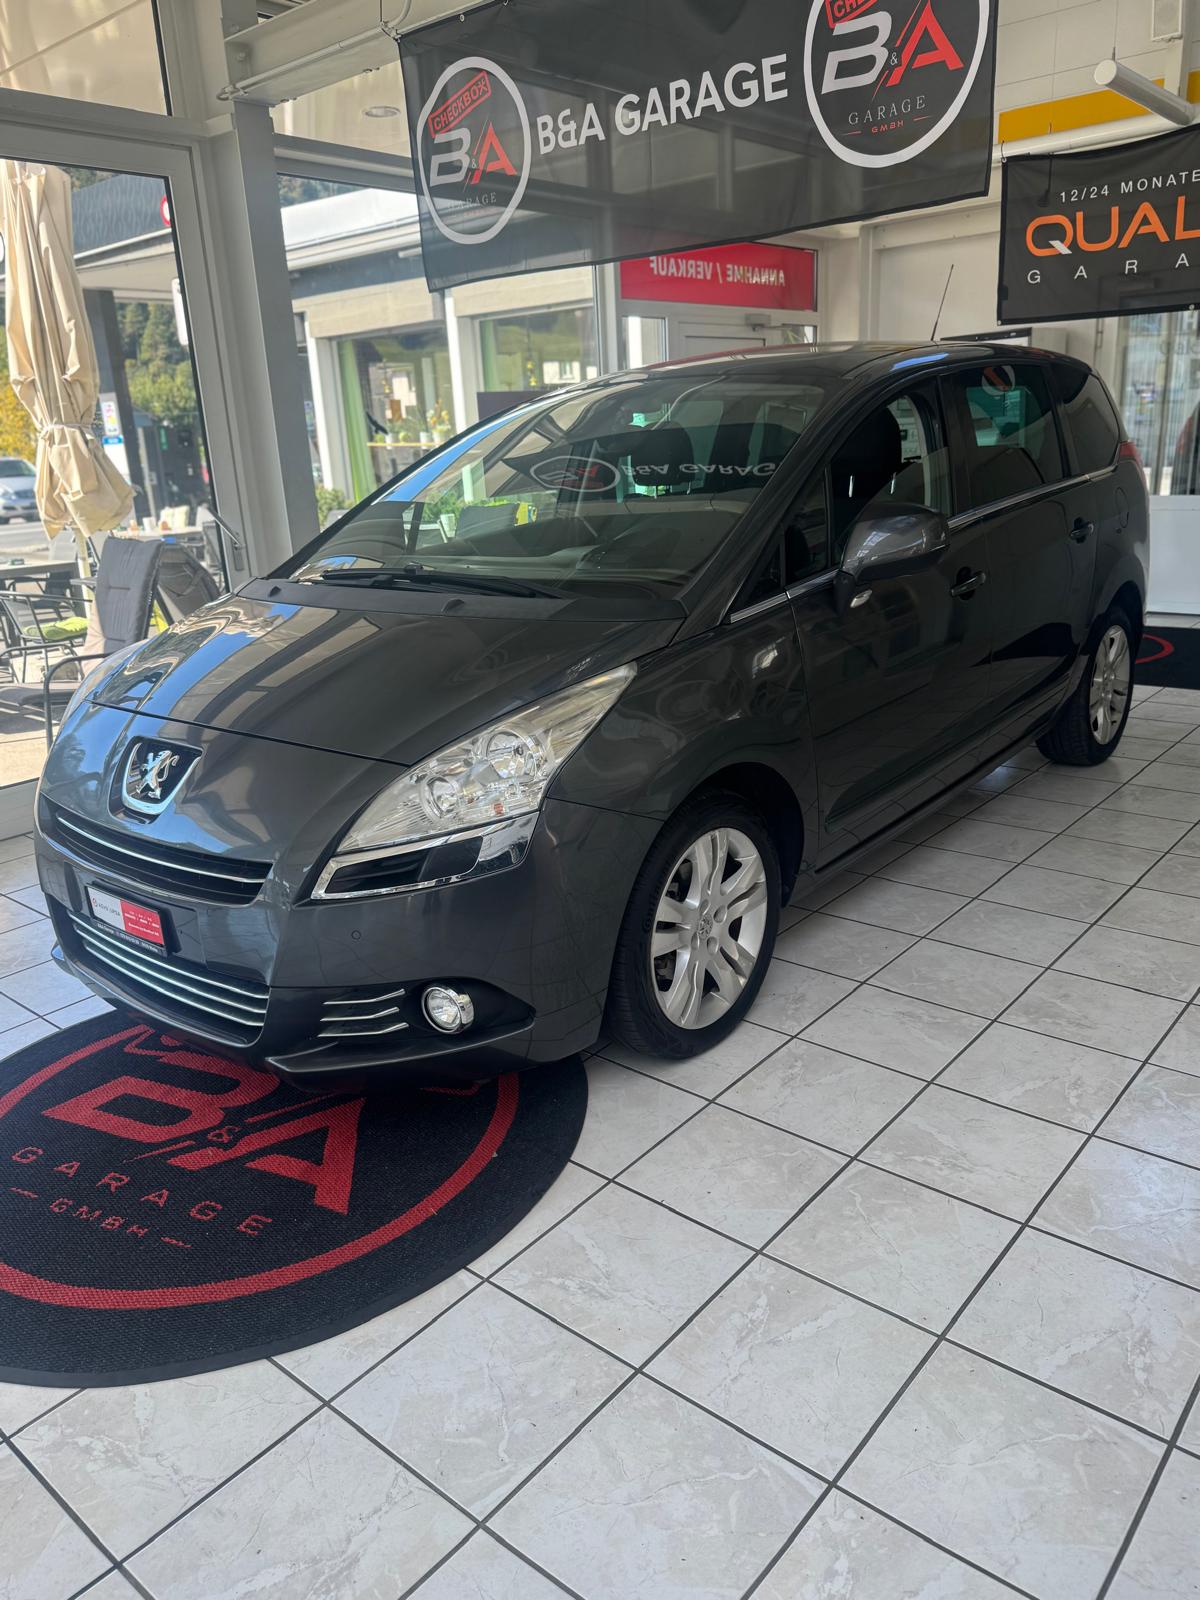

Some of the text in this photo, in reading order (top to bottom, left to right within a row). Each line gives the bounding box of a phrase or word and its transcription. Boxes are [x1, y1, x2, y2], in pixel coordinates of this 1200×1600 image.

[433, 79, 488, 131] CHECKBOX
[537, 53, 788, 154] B&A GARAGE
[848, 95, 927, 126] GARAGE
[1060, 169, 1200, 202] 12/24 MONATE
[11, 1146, 273, 1236] GARAGE
